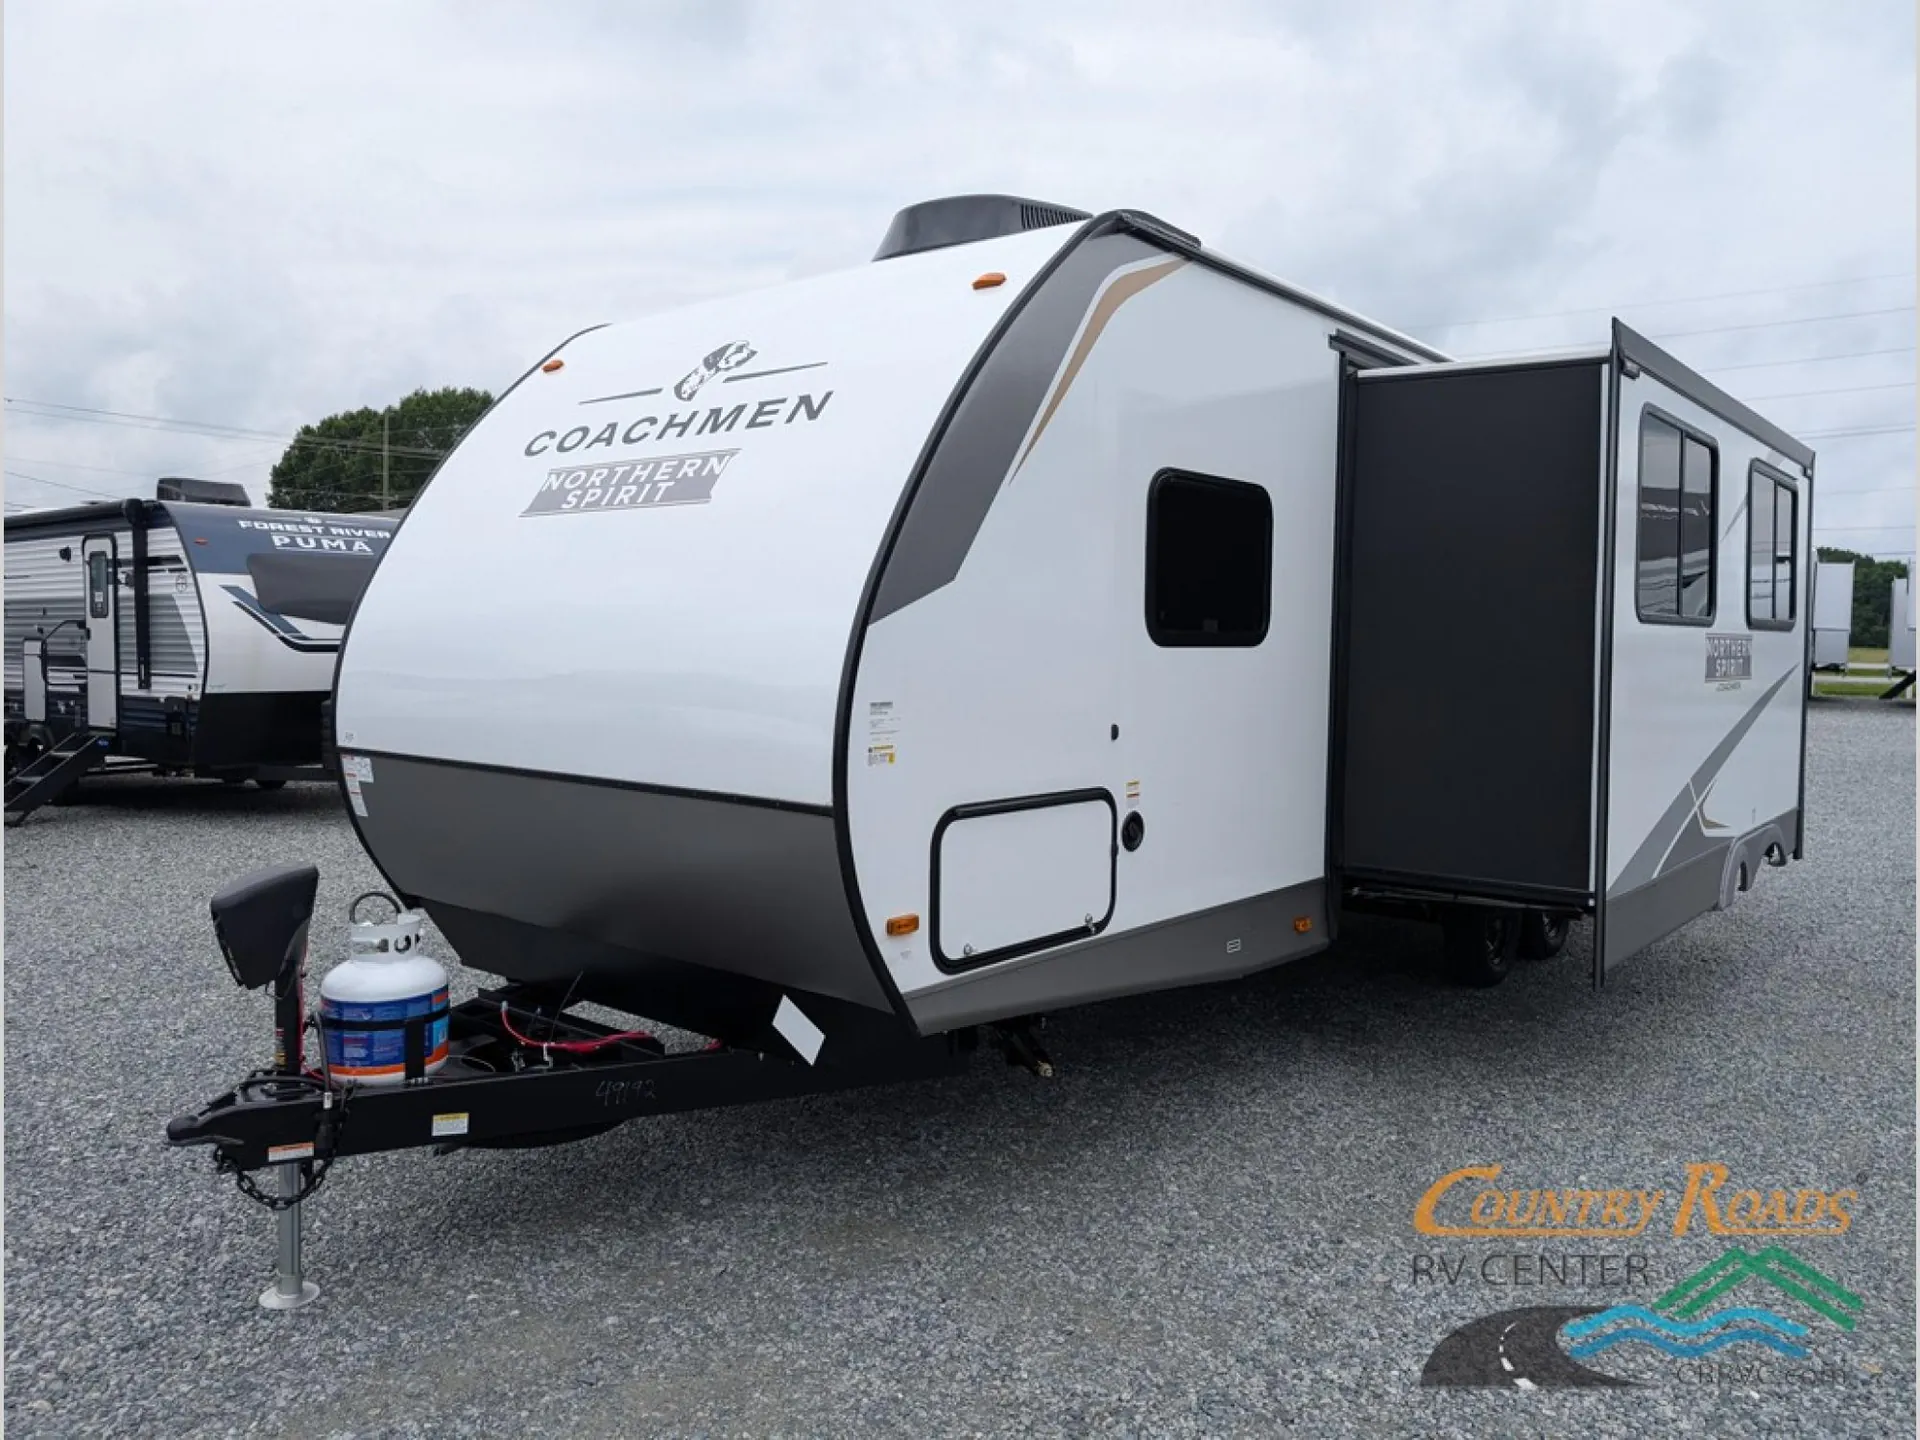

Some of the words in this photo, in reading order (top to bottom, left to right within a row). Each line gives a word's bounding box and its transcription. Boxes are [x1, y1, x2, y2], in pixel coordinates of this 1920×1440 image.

[524, 390, 834, 457] COACHMEN
[542, 455, 731, 492] NORTHERN
[560, 481, 676, 511] SPIRIT
[237, 520, 325, 535] FOREST
[330, 526, 392, 539] RIVER
[271, 534, 374, 553] PUMA
